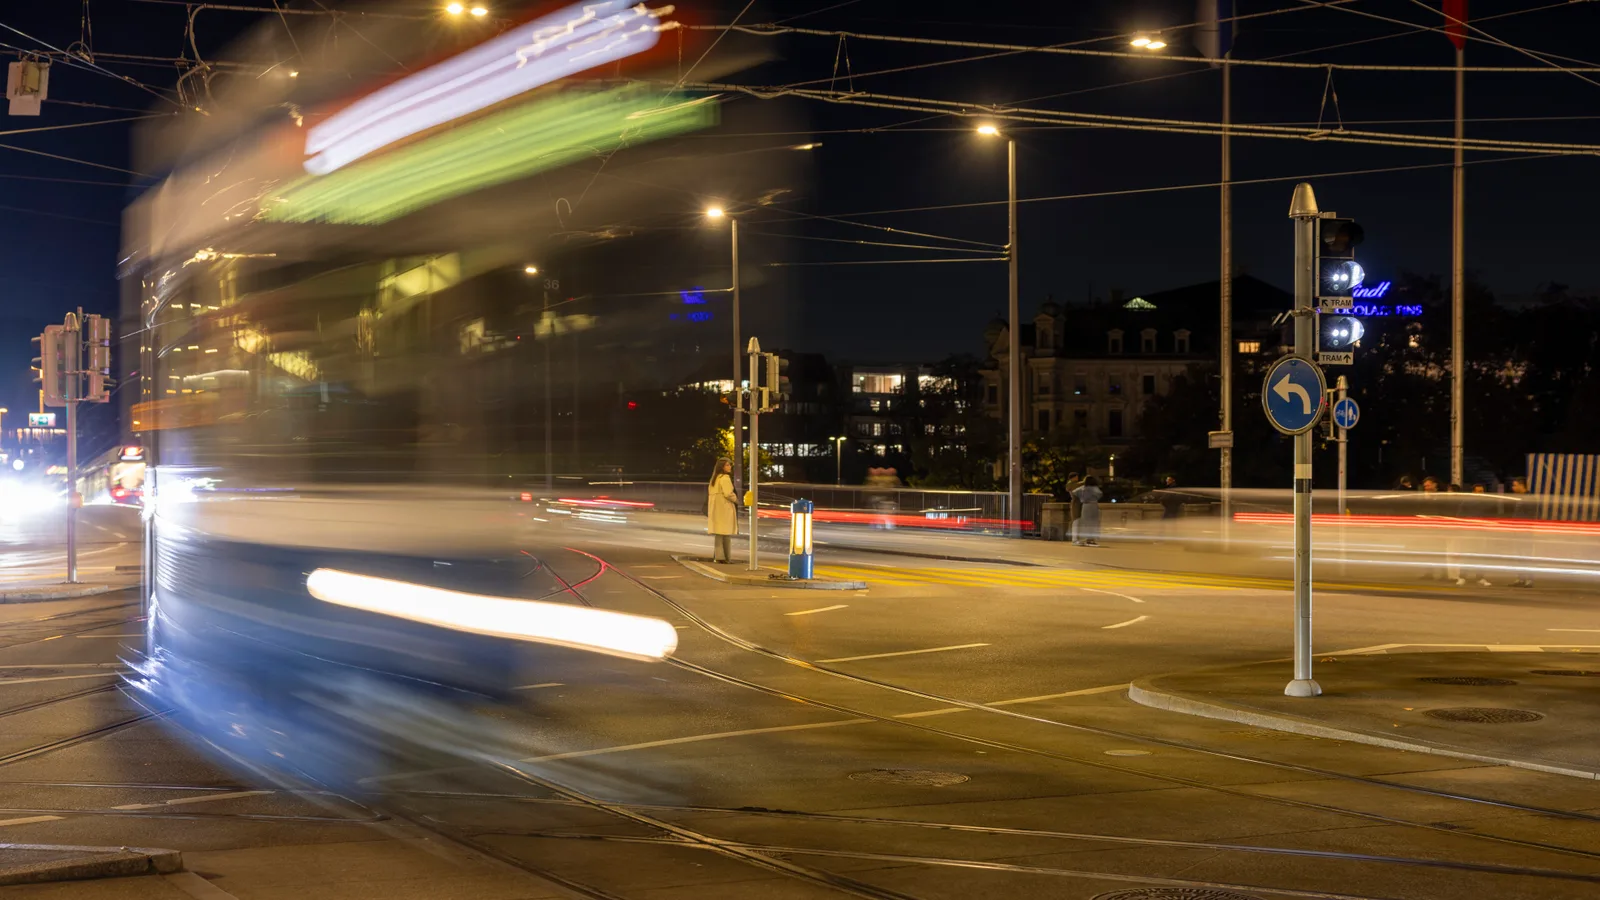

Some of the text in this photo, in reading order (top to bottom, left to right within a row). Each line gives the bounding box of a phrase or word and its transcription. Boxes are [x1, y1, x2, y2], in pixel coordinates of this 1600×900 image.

[1352, 281, 1391, 298] indt
[1331, 299, 1352, 307] TRAM
[1322, 354, 1343, 362] TRAM
